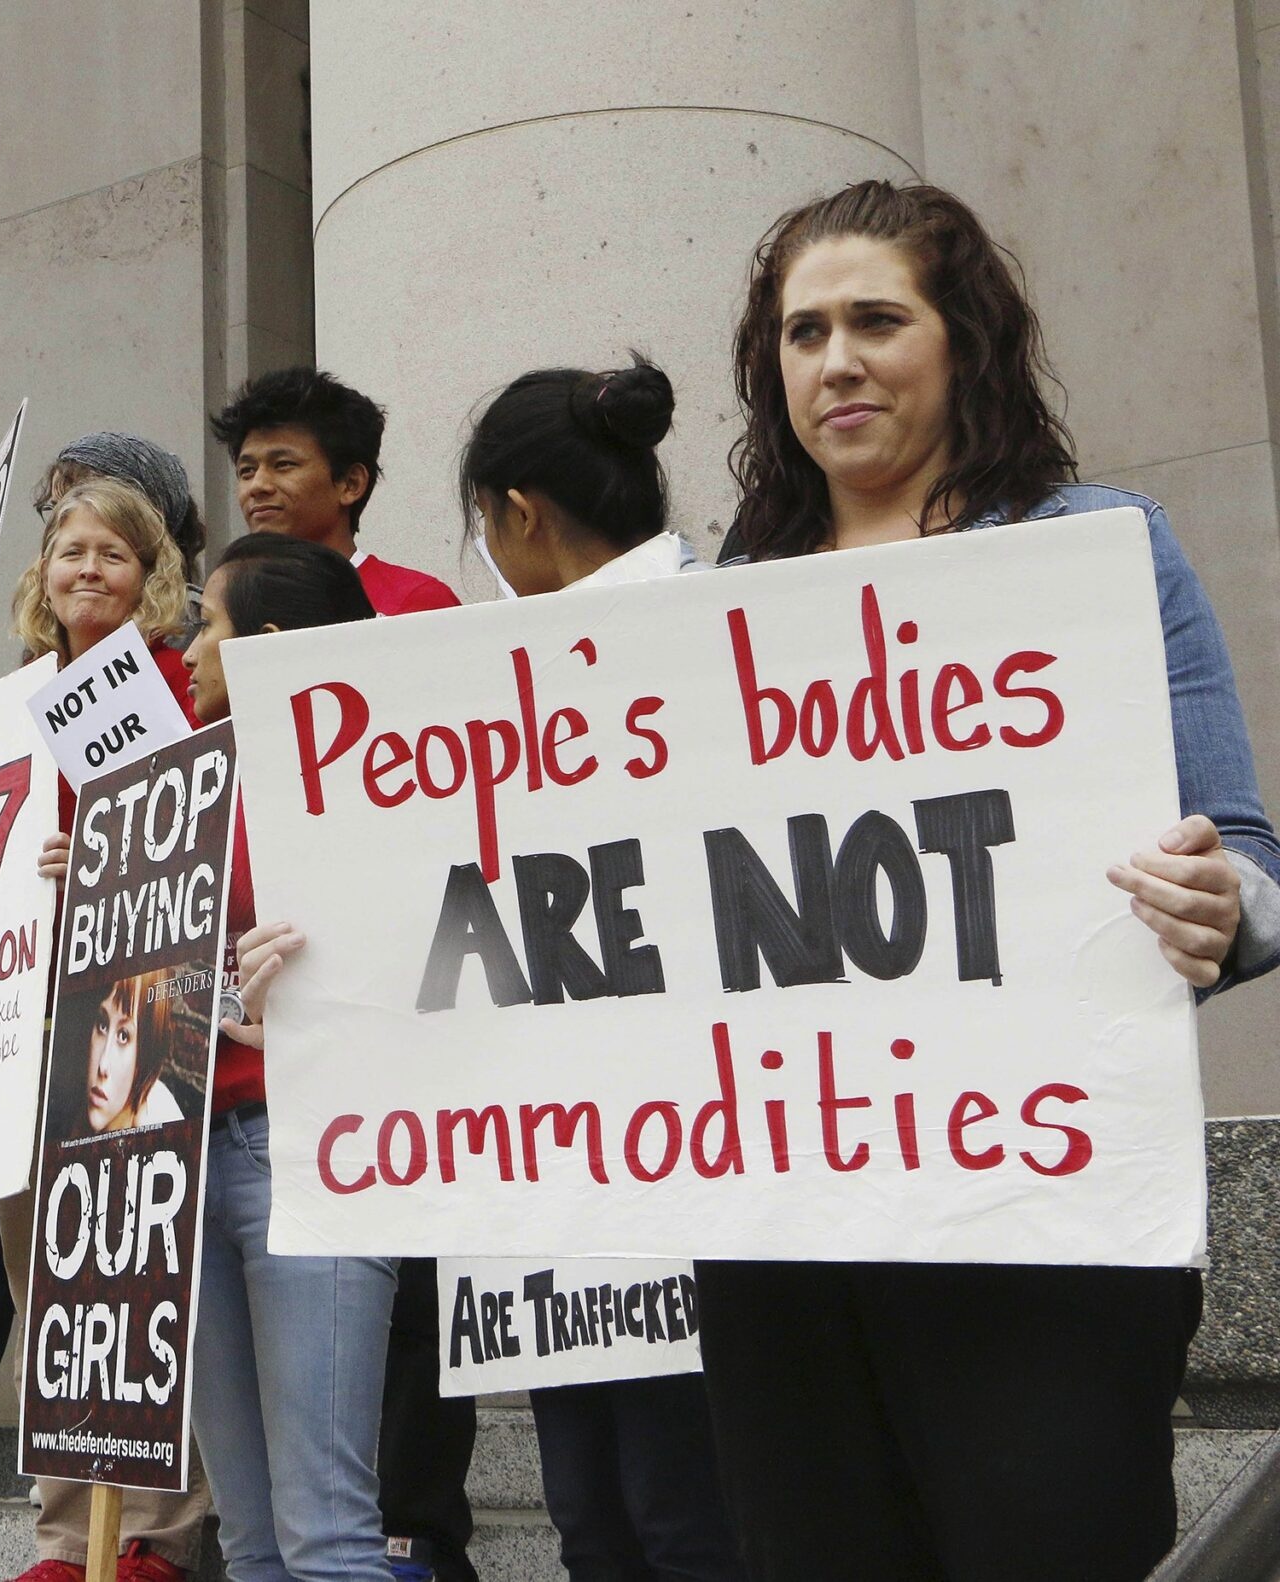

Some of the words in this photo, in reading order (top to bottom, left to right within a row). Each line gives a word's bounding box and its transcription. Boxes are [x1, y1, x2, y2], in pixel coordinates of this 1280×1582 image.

[45, 677, 98, 734] NOT
[103, 650, 140, 689] IN
[84, 712, 147, 768] OUR
[289, 637, 670, 883] People's
[726, 583, 1066, 766] bodies
[77, 749, 228, 888] STOP
[68, 863, 216, 975] BUYING
[414, 836, 665, 1014] ARE
[702, 788, 1018, 993] NOT
[147, 970, 214, 1003] DEFENDERS
[318, 1022, 1094, 1196] commodities
[45, 1150, 187, 1280] OUR
[37, 1300, 178, 1405] GIRLS
[449, 1275, 521, 1368] ARE
[523, 1268, 700, 1357] TRAFFICKED
[32, 1430, 174, 1467] www.thedefendersusa.org
